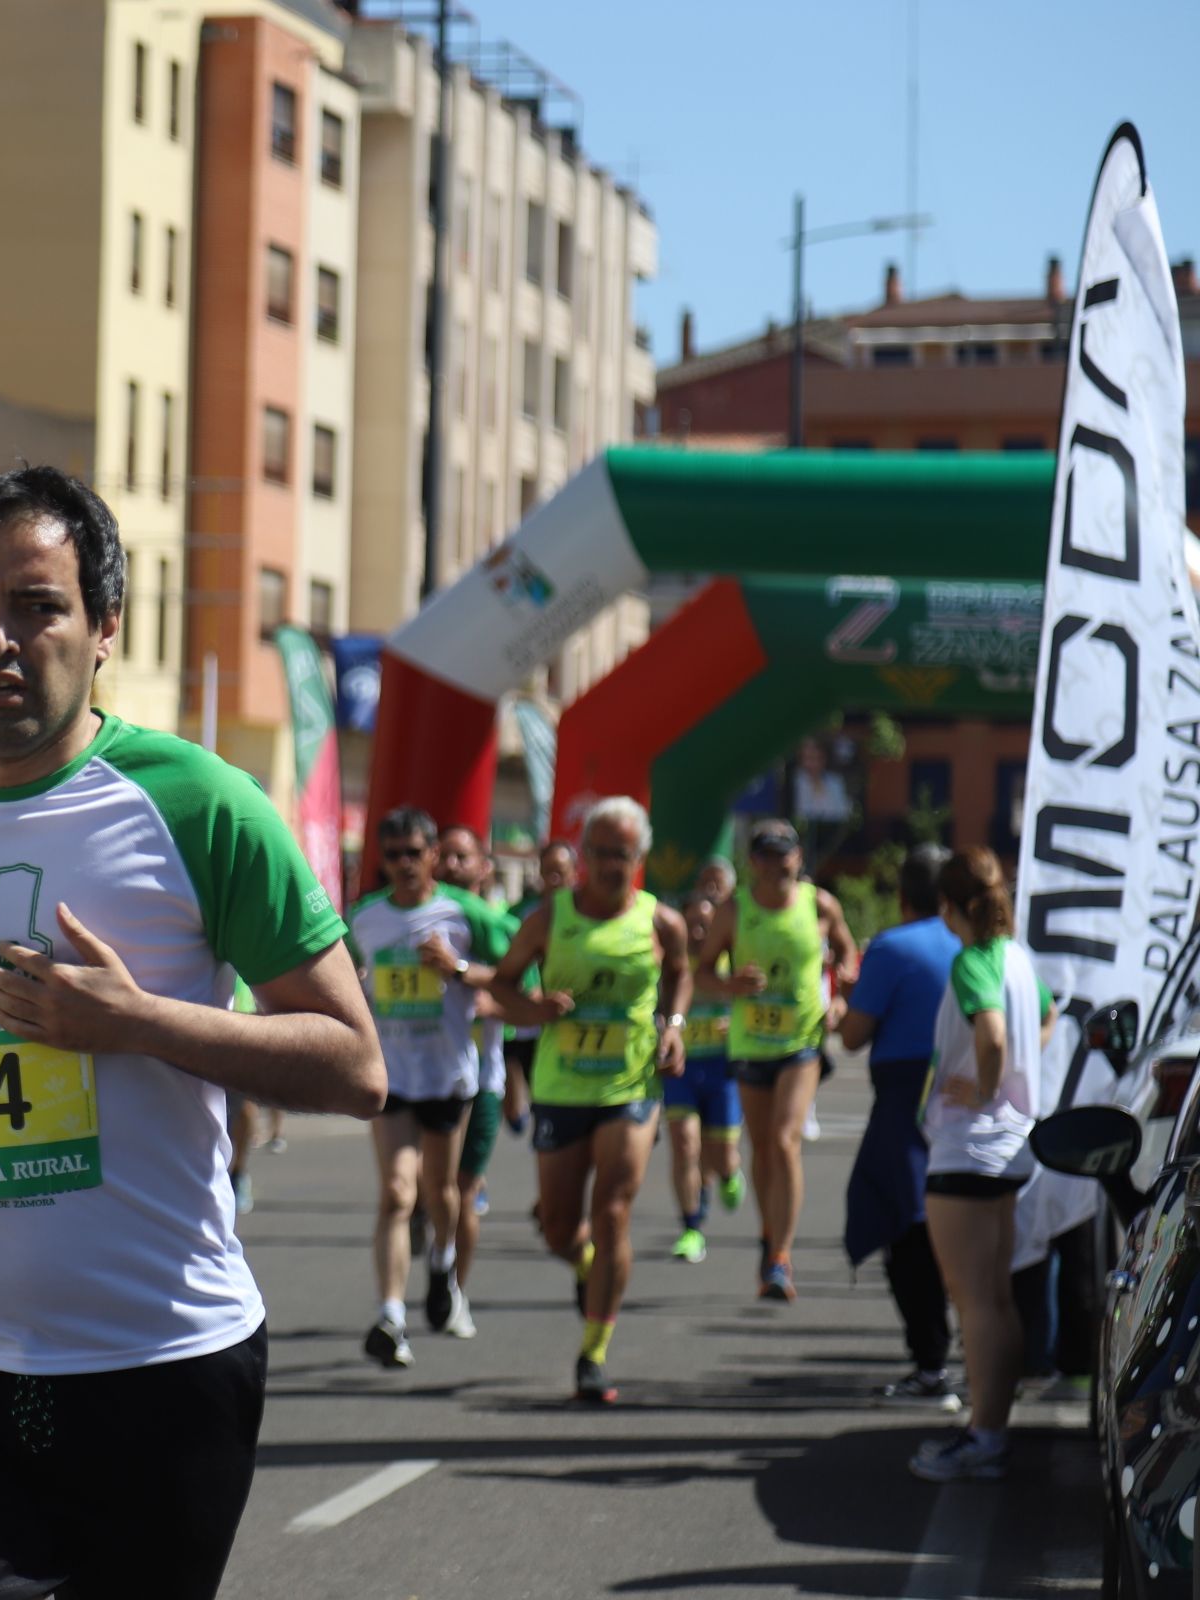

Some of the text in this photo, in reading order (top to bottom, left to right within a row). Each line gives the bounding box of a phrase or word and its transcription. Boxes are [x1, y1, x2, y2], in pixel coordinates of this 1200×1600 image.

[575, 1023, 609, 1049] 77
[11, 1153, 91, 1181] RURAL
[13, 1197, 57, 1209] ZAMORA
